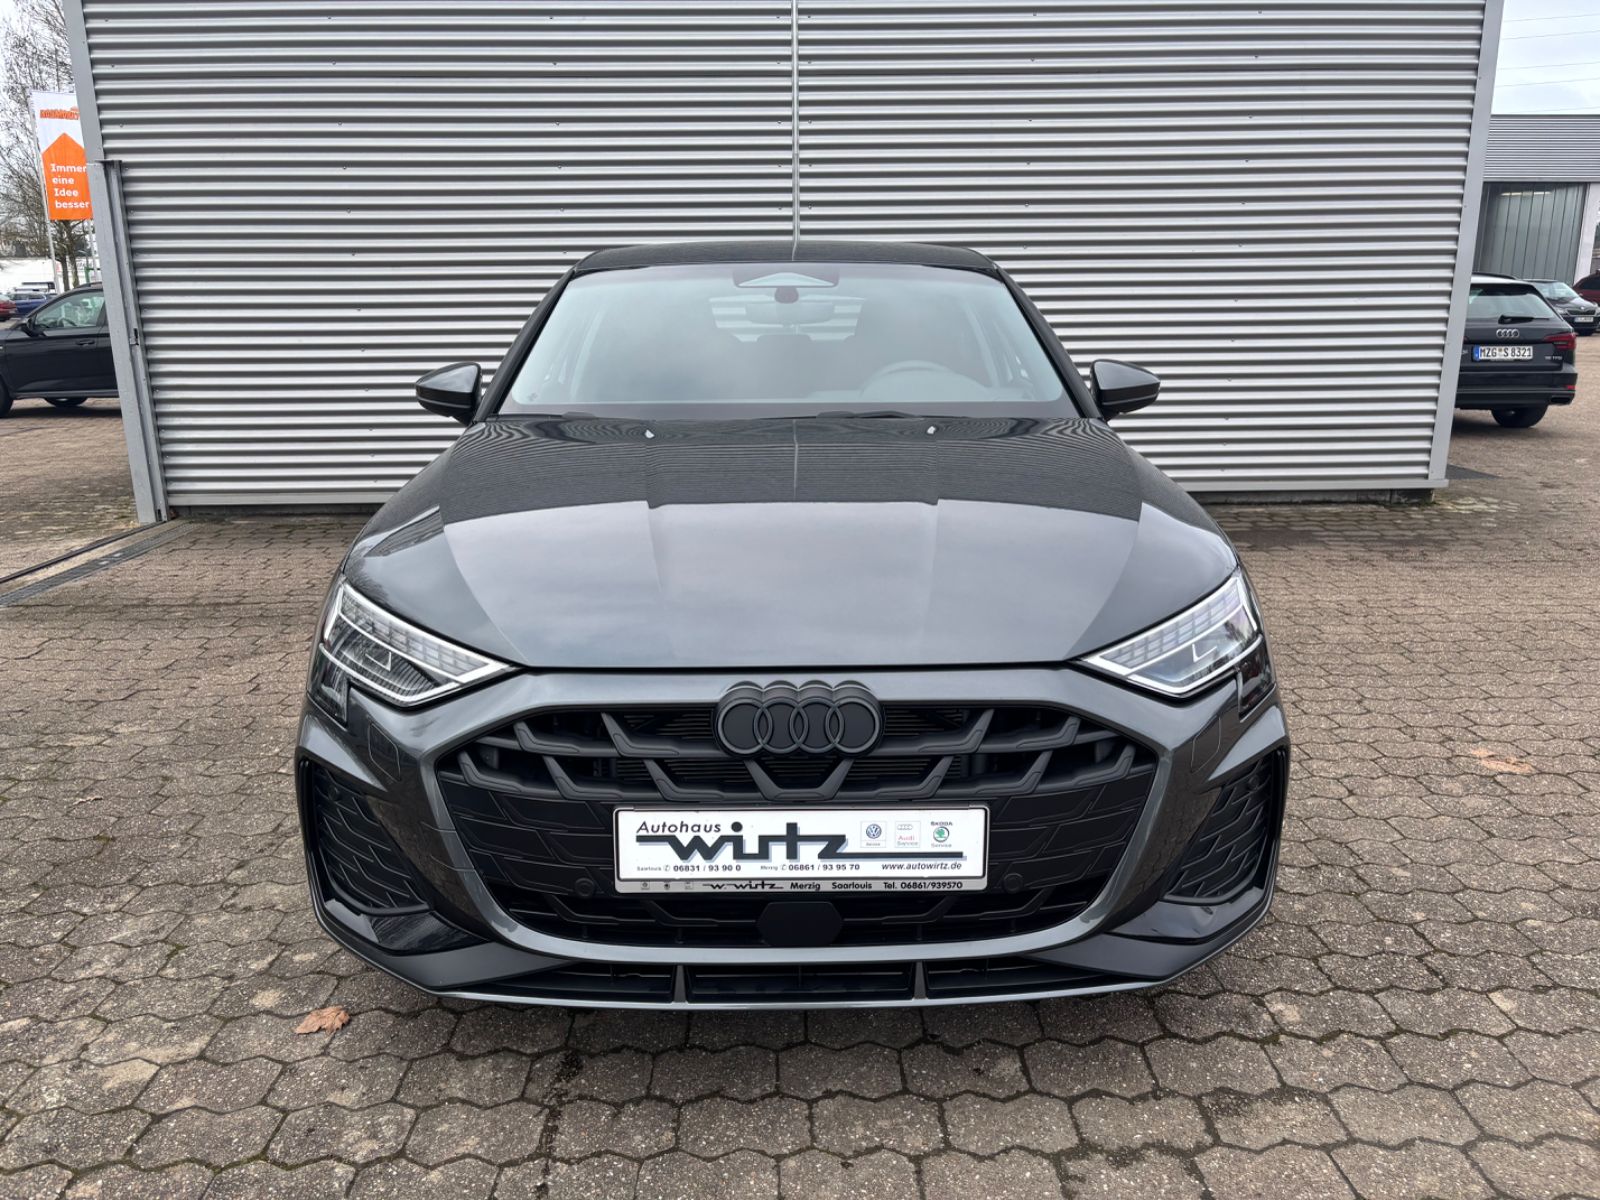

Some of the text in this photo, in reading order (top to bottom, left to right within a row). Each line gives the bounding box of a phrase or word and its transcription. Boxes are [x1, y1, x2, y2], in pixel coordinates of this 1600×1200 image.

[50, 163, 87, 173] Immer
[52, 176, 75, 185] eine
[54, 187, 79, 197] Idee
[55, 200, 90, 209] besser
[1480, 346, 1497, 357] MZG
[1503, 346, 1509, 357] S
[1510, 346, 1532, 357] 8321
[635, 820, 722, 834] Autohaus
[673, 864, 700, 872] 06831
[708, 864, 719, 872] 93
[721, 864, 733, 872] 90
[735, 864, 742, 872] 0
[881, 860, 962, 871] www.autowirtz.de
[790, 882, 821, 892] Merzig
[831, 882, 872, 890] Saarlouis
[884, 882, 897, 890] Tel.
[900, 882, 963, 890] 06861/939570
